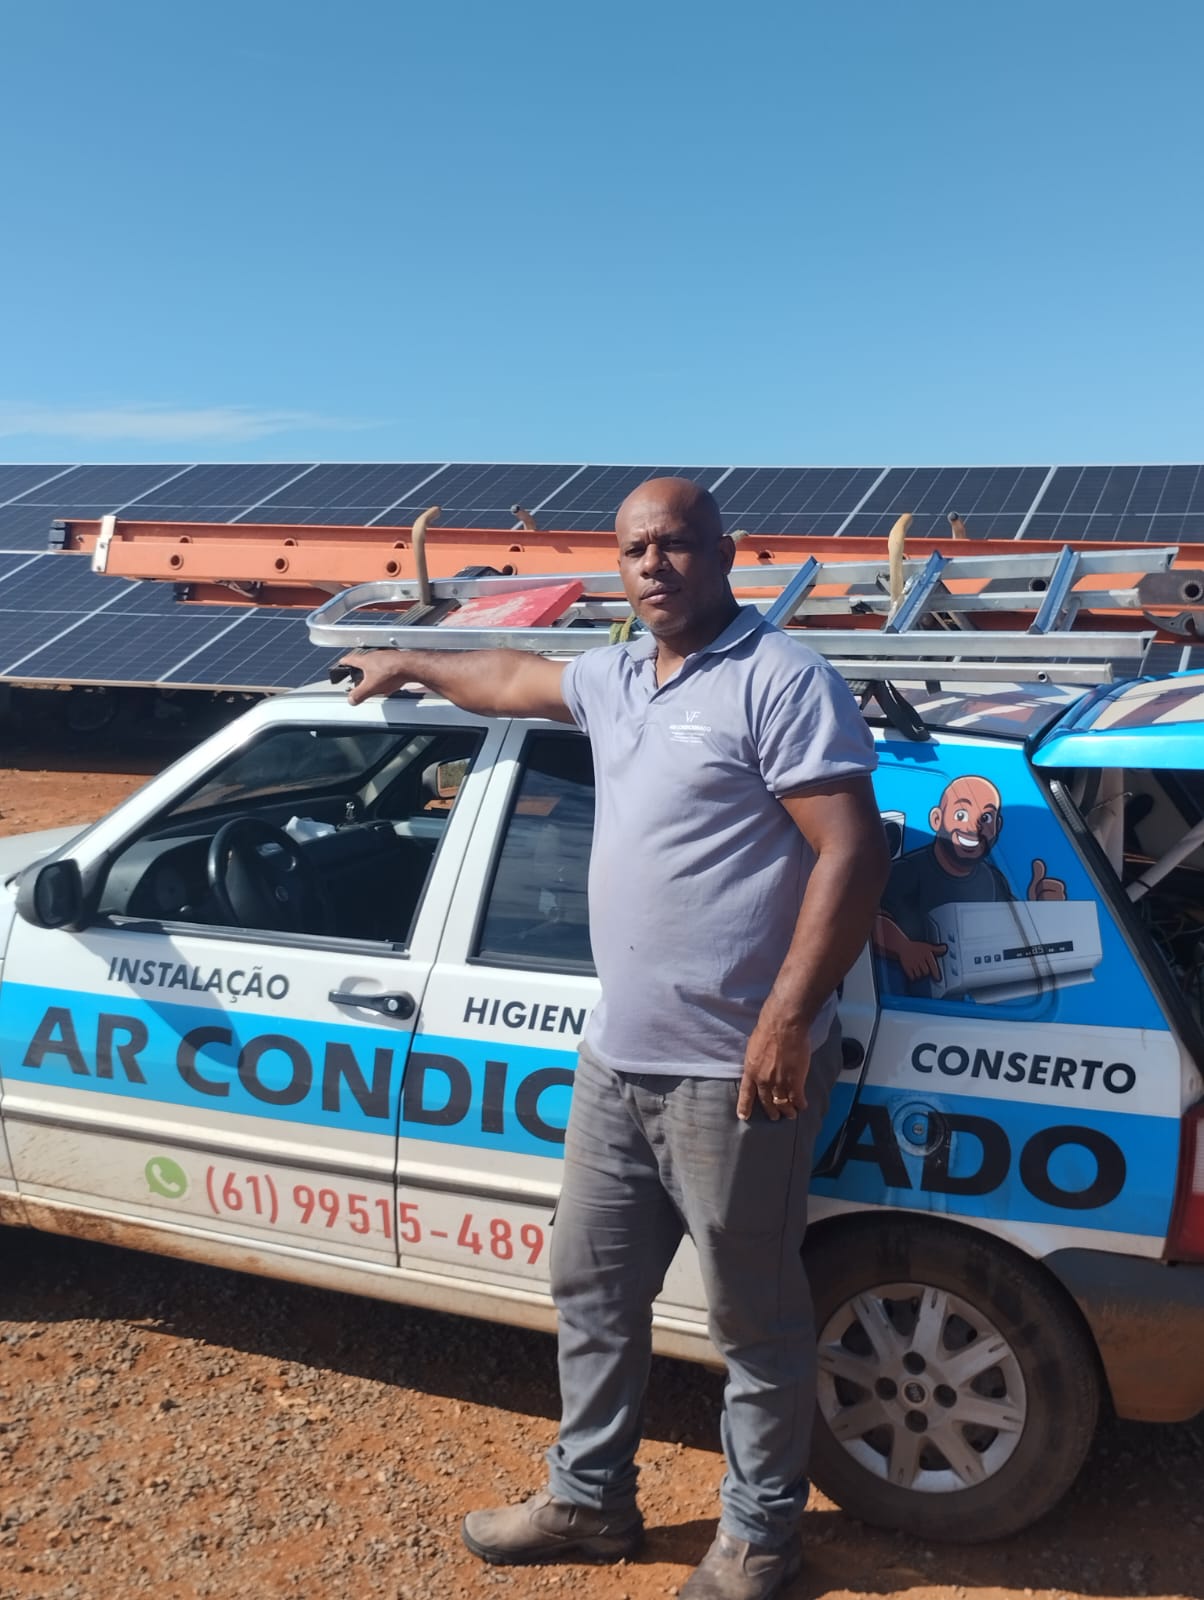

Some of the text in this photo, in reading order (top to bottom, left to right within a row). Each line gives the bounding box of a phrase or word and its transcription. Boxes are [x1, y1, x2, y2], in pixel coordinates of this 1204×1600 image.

[107, 957, 290, 1003] INSTALAÇÃO
[463, 997, 594, 1035] HIGIEN
[911, 1042, 1137, 1093] CONSERTO
[23, 1006, 1127, 1210] AR CONDIC ADO
[205, 1166, 544, 1265] (61) 99515-489
